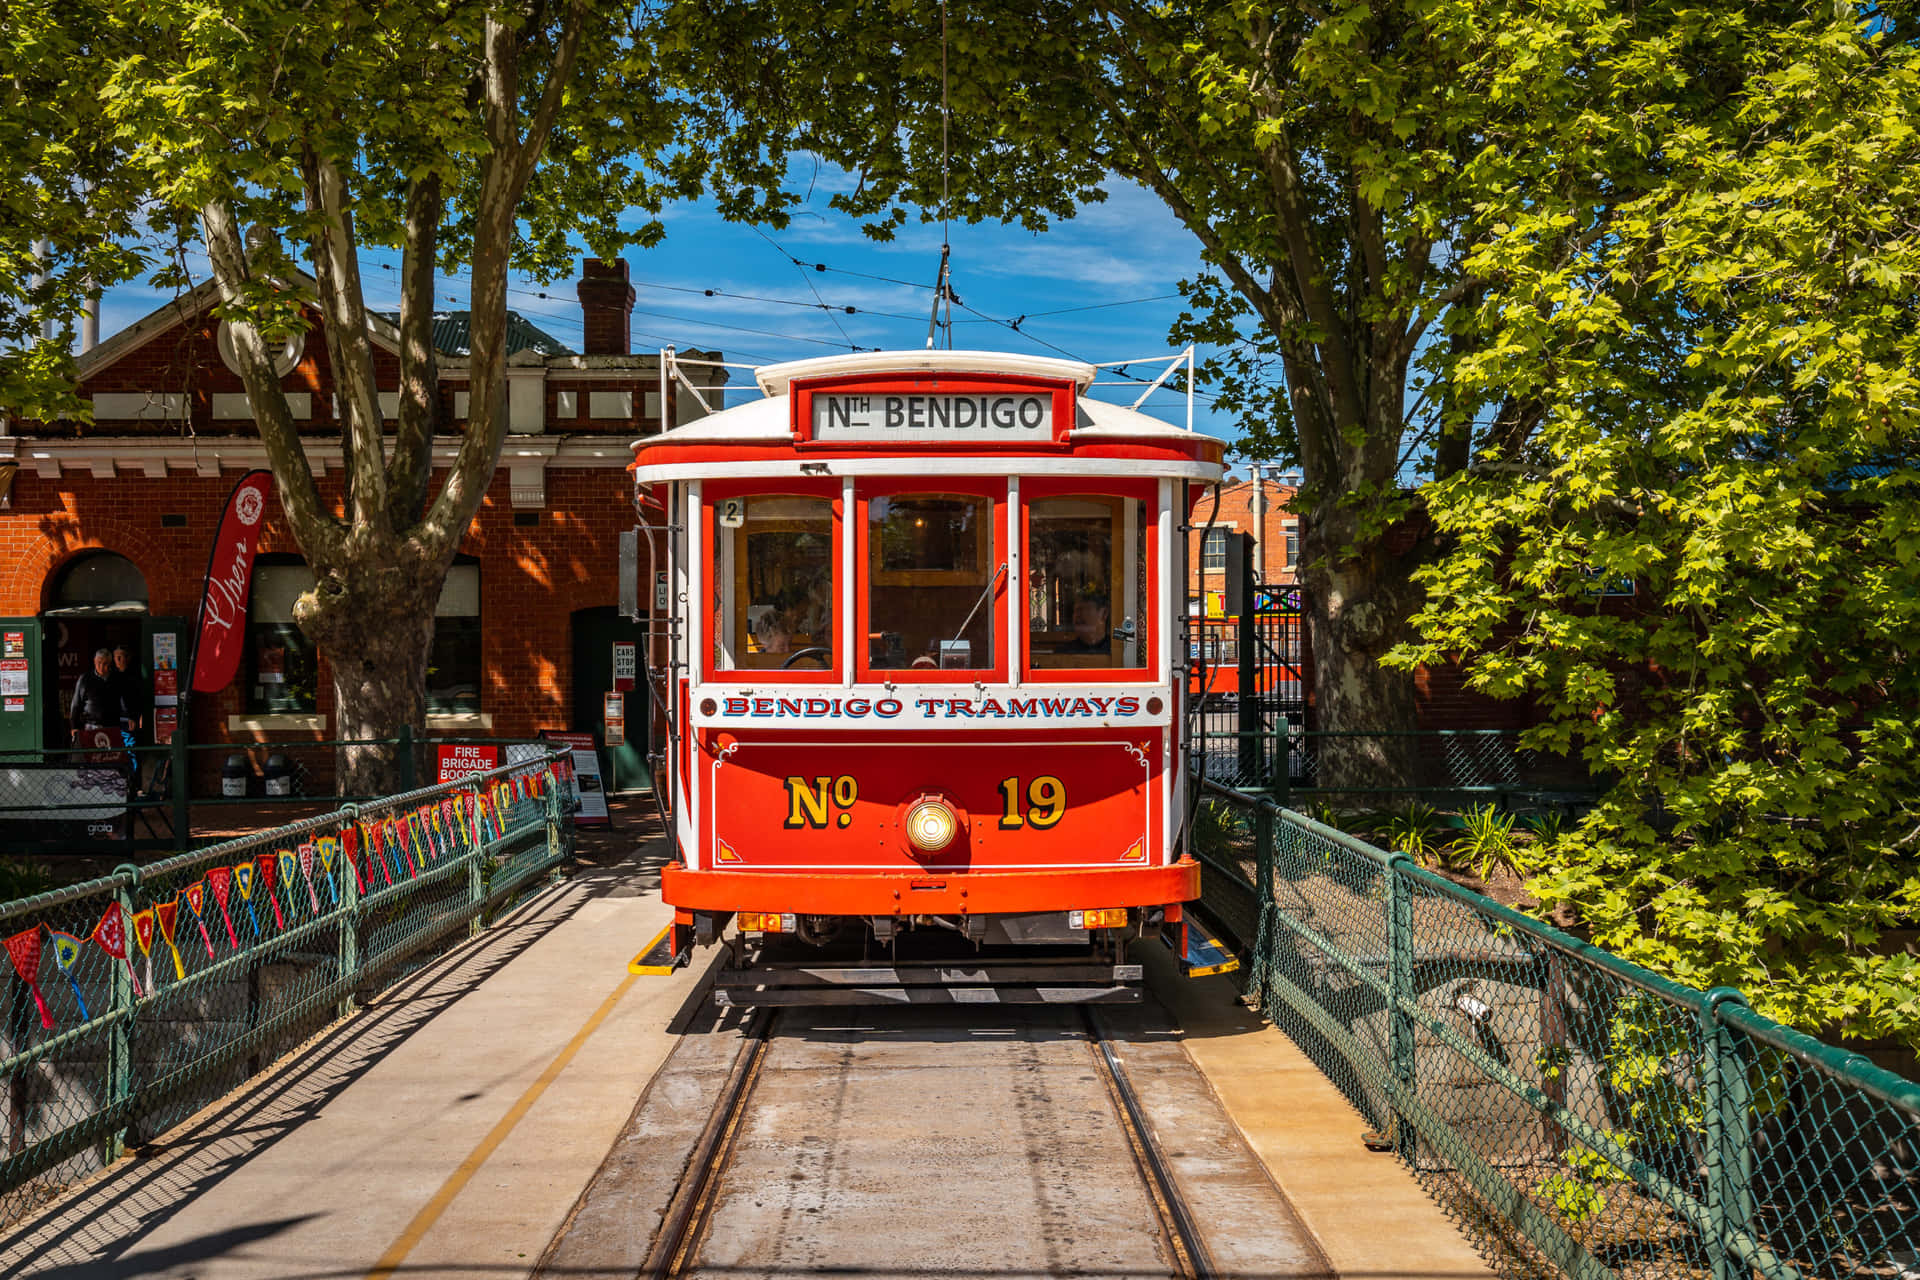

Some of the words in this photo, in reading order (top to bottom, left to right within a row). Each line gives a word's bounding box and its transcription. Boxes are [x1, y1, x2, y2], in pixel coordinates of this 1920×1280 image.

[883, 397, 1043, 429] BENDIGO
[727, 502, 738, 521] 2
[616, 648, 634, 656] CARS
[616, 658, 634, 666] STOP
[616, 667, 634, 676] HERE
[723, 697, 905, 718] BENDIGO
[915, 695, 1141, 718] TRAMWAYS
[455, 747, 480, 758] FIRE
[442, 758, 493, 770] BRIGADE
[440, 769, 472, 780] BOOS
[998, 776, 1067, 831] 19
